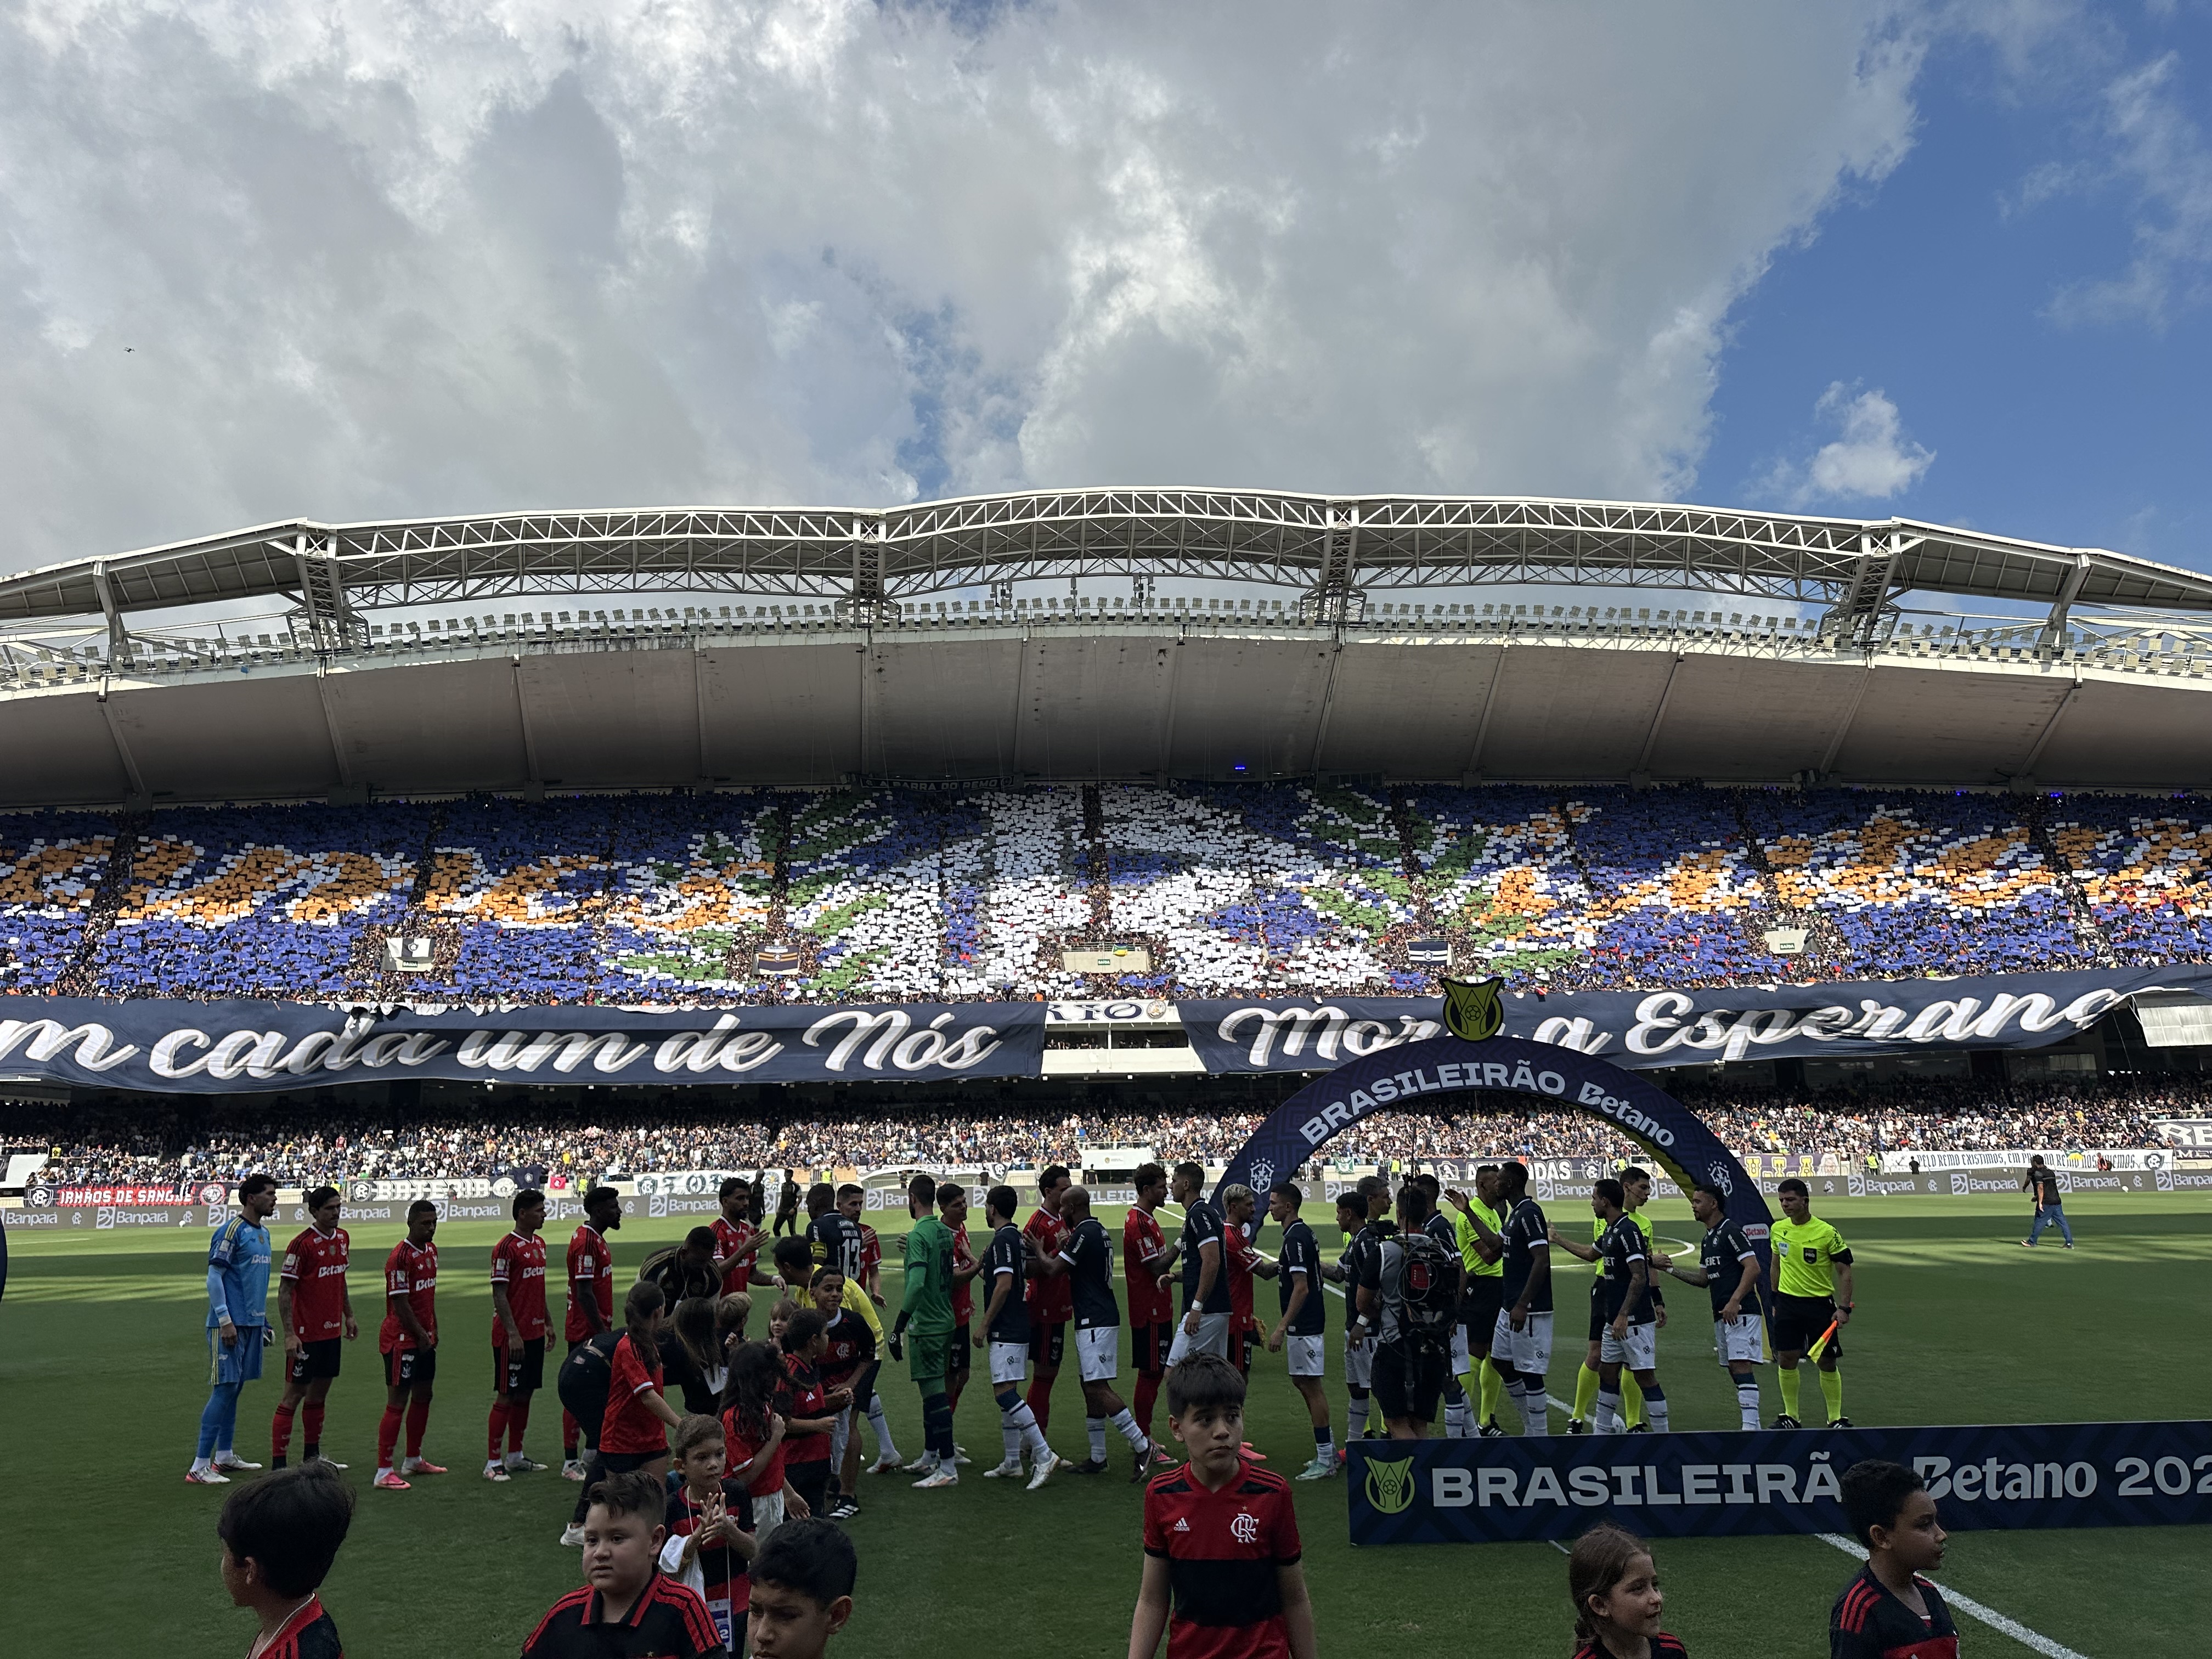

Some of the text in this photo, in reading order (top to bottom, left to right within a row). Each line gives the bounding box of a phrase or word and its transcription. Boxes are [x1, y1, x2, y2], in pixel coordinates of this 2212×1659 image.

[1217, 1006, 1506, 1066] Mor
[1534, 1017, 1613, 1054] a
[150, 1011, 451, 1080] cada
[456, 1030, 650, 1073] um
[654, 1013, 785, 1073] de
[802, 1010, 1003, 1071] Nós
[1299, 1059, 1674, 1147] BRASILEIRÃO Betano
[1866, 1178, 1915, 1193] Banpará
[1970, 1177, 2019, 1190] Banpará
[2072, 1175, 2121, 1188] Banpará
[115, 1190, 133, 1203] DE
[1555, 1183, 1594, 1197] Banpa
[6, 1211, 58, 1226] Banpará
[116, 1210, 168, 1224] Banpará
[449, 1205, 501, 1218] Banpará
[1746, 1228, 1767, 1237] Betano
[1432, 1451, 1842, 1507] BRASILEIRÃ
[1913, 1456, 2098, 1502] Betano
